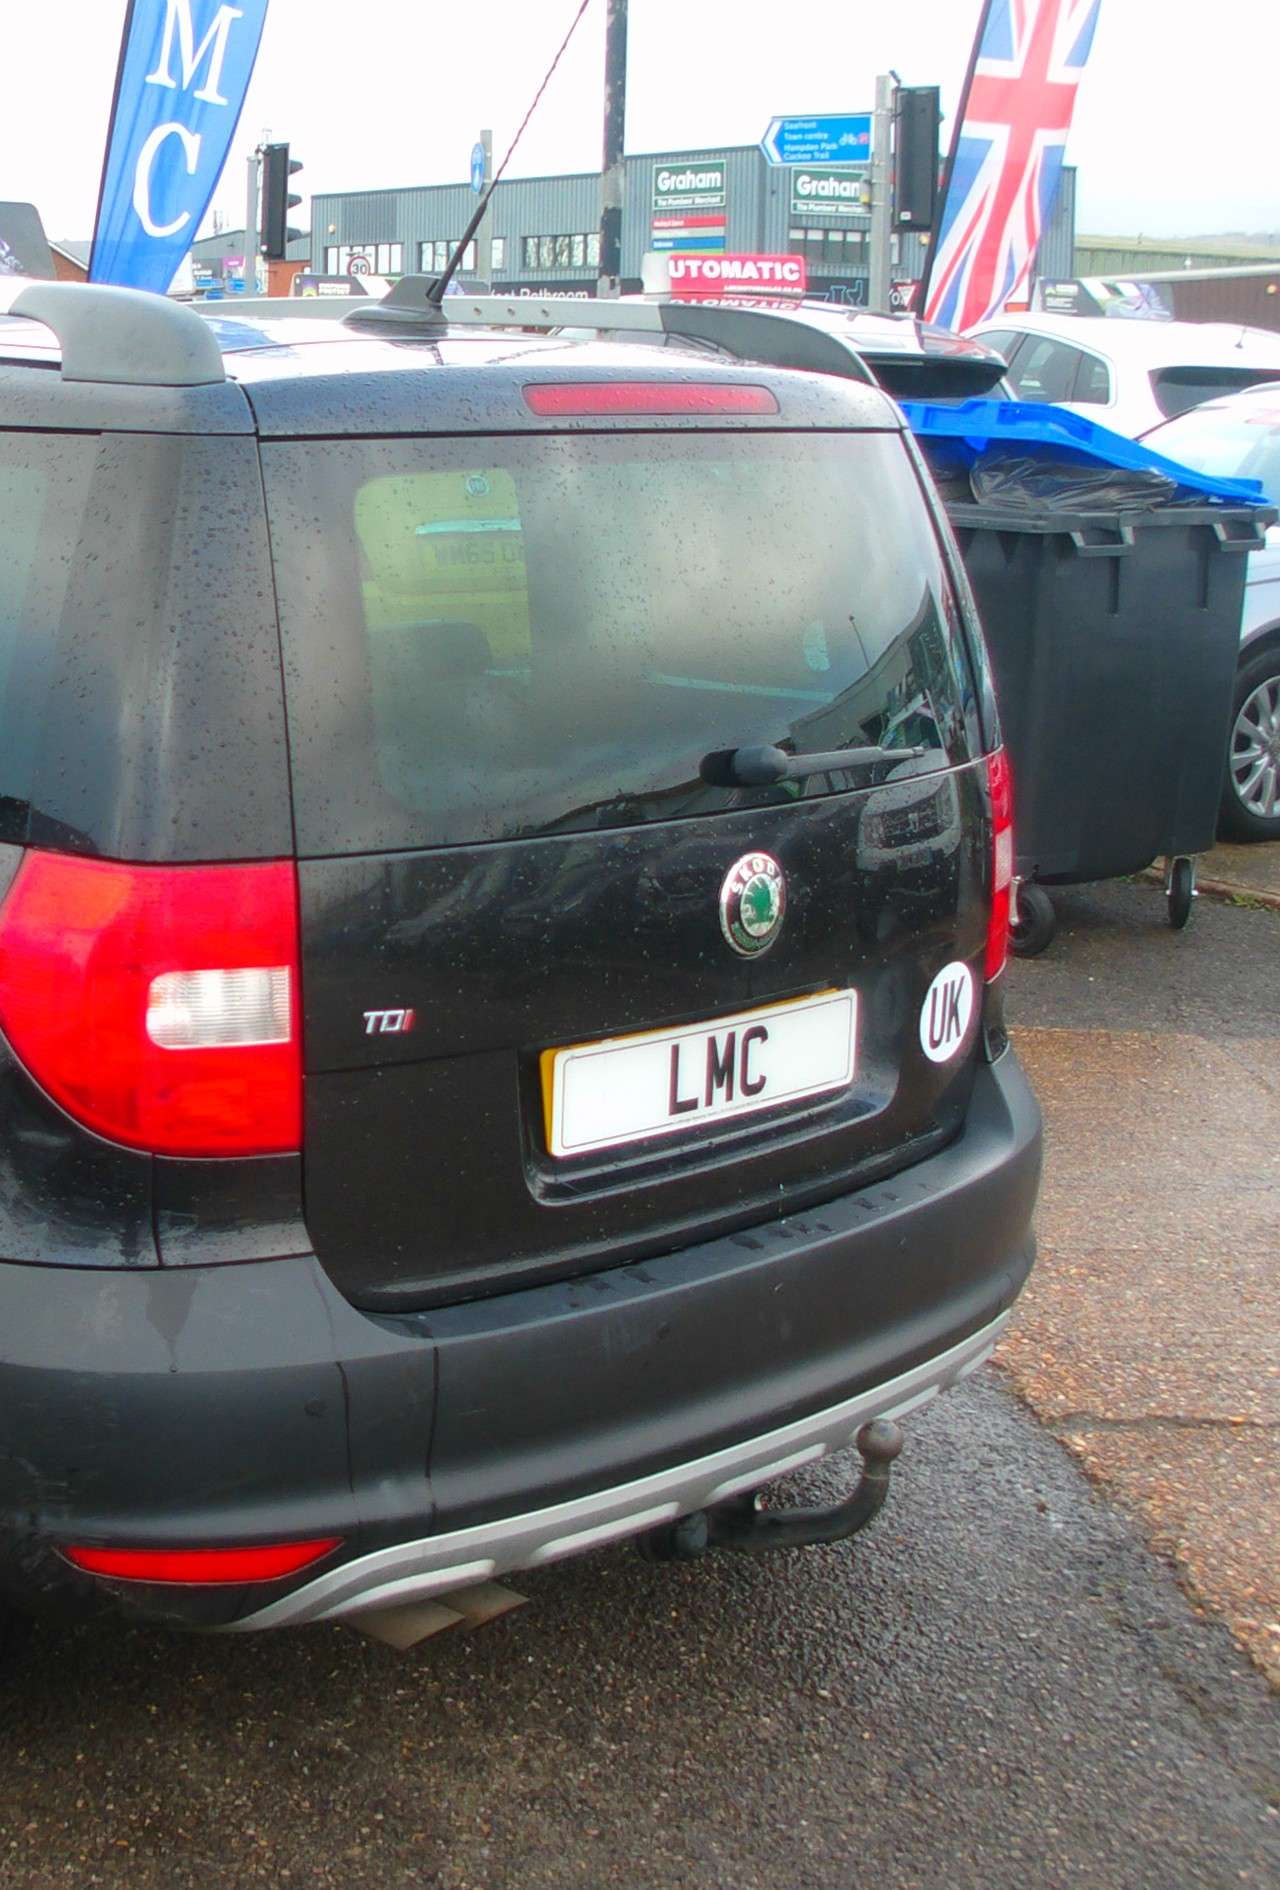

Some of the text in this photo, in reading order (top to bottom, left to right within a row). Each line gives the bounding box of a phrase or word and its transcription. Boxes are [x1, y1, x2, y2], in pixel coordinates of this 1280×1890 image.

[784, 133, 803, 141] Town
[657, 170, 722, 191] Graham
[351, 263, 368, 276] 30
[668, 259, 801, 281] UTOMATIC
[928, 974, 966, 1050] UK
[668, 1024, 769, 1116] LMC
